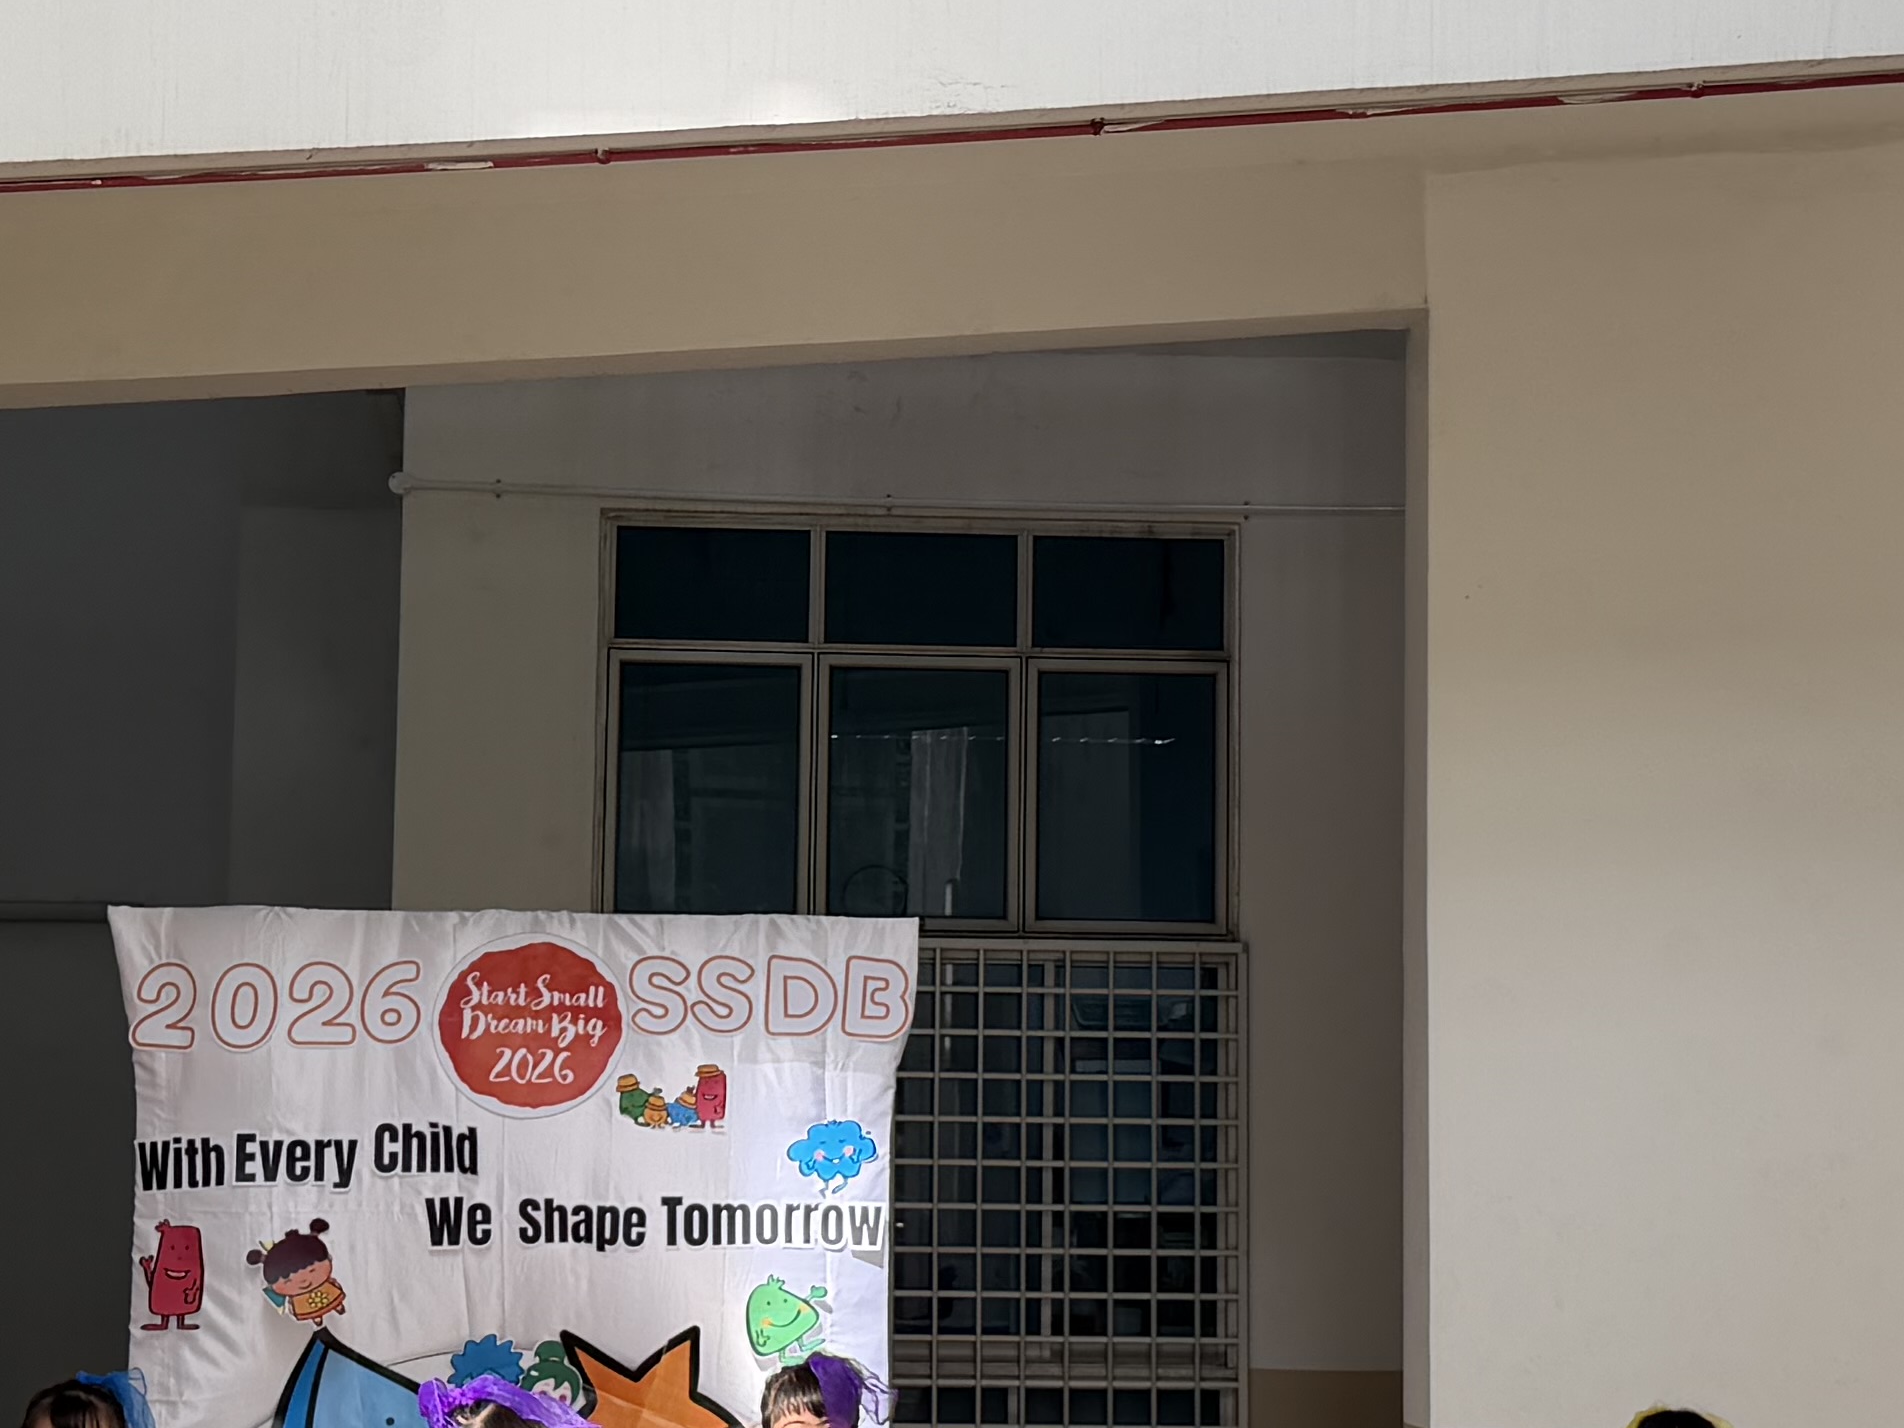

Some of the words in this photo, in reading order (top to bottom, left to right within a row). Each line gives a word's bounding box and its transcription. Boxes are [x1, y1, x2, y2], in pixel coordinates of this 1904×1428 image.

[131, 960, 421, 1050] 2026
[460, 971, 530, 1008] Start
[530, 974, 606, 1010] Small
[628, 954, 909, 1039] SSDB
[460, 1006, 548, 1040] Dream
[550, 1011, 607, 1048] Big
[489, 1047, 575, 1084] 2026
[137, 1137, 226, 1191] With
[234, 1132, 358, 1189] Every
[373, 1122, 478, 1176] Child
[424, 1196, 492, 1247] We
[518, 1197, 647, 1252] Shape
[661, 1196, 882, 1248] Tomorrow
